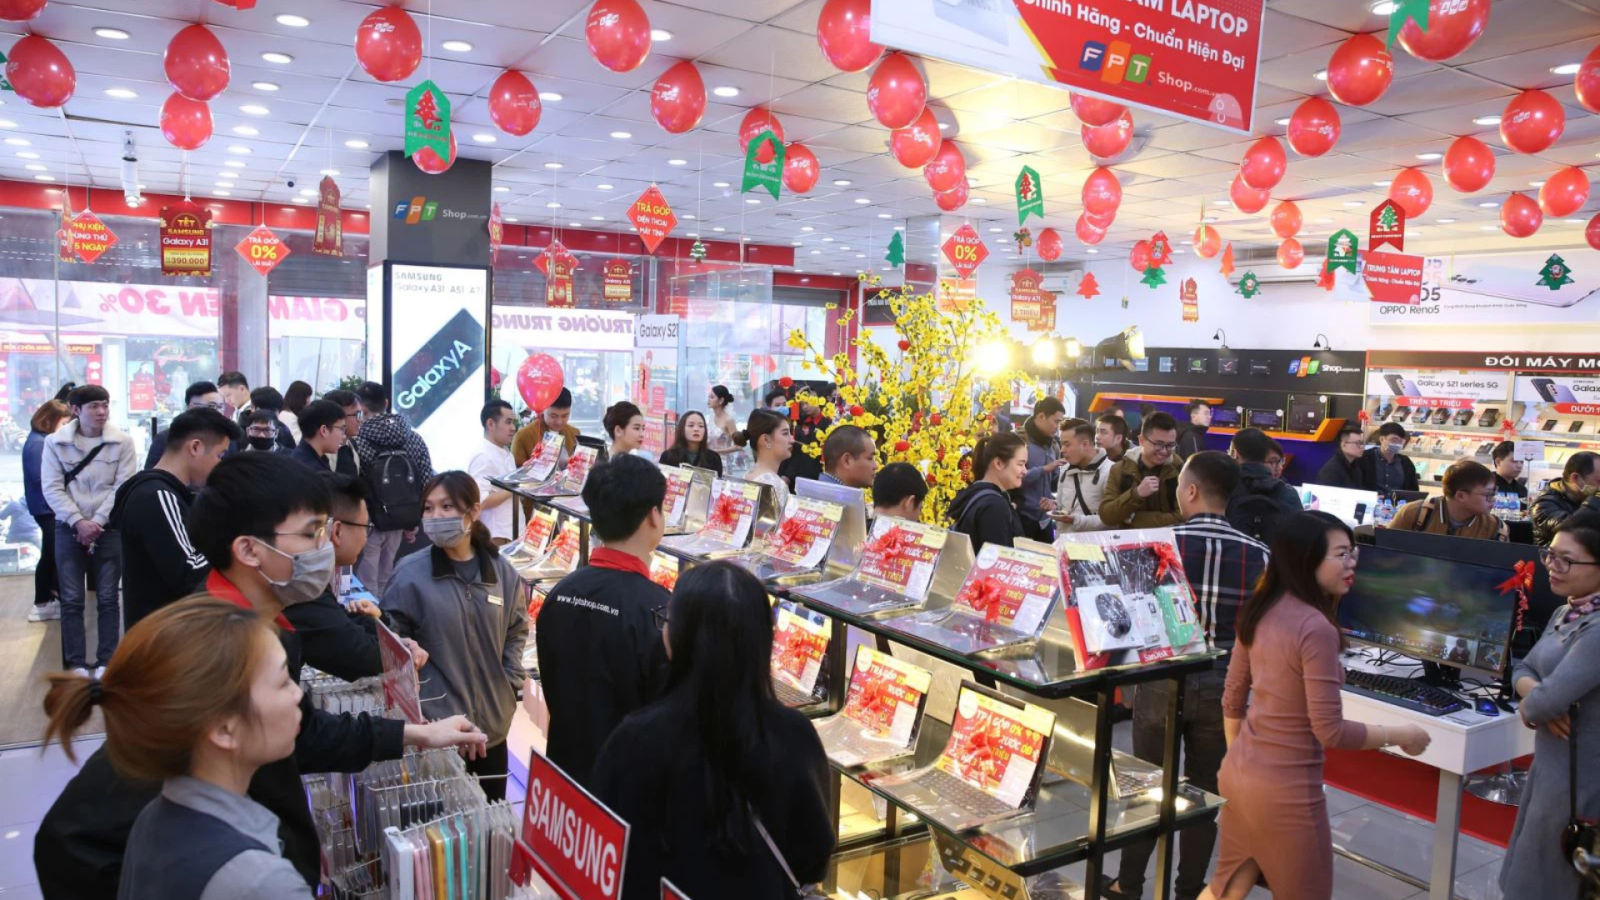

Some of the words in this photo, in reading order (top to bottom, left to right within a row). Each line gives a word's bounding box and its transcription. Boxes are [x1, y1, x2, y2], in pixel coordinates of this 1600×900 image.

[1171, 0, 1248, 38] LAPTOP
[1077, 4, 1120, 35] Hãng
[1134, 22, 1183, 50] Chuẩn
[1187, 38, 1218, 62] Hiện
[1222, 49, 1245, 72] Đại
[1082, 44, 1149, 79] FPT
[394, 200, 437, 221] FPT
[636, 201, 651, 213] TRẢ
[653, 205, 671, 216] GÓP
[178, 216, 195, 227] TẾT
[163, 237, 194, 247] Galaxy
[195, 238, 208, 246] A31
[251, 245, 277, 260] 0%
[955, 246, 977, 262] 0%
[395, 272, 442, 282] SAMSUNG
[1367, 264, 1386, 273] TRUNG
[1401, 268, 1421, 277] LAPTOP
[395, 282, 429, 293] Galaxy
[1380, 305, 1407, 315] OPPO
[1410, 305, 1440, 314] Reno5
[639, 323, 666, 339] Galaxy
[1288, 358, 1319, 376] FPT
[1525, 355, 1572, 368] MÁY
[1417, 380, 1445, 388] Galaxy
[1486, 381, 1498, 389] 5G
[1408, 397, 1428, 406] TRÊN
[1570, 404, 1595, 413] DƯỚI
[995, 559, 1012, 571] TRẢ
[1011, 563, 1030, 575] GÓP
[556, 594, 620, 617] www.fptshop.com.vn
[1143, 650, 1170, 662] SanDisk
[528, 777, 617, 897] SAMSUNG
